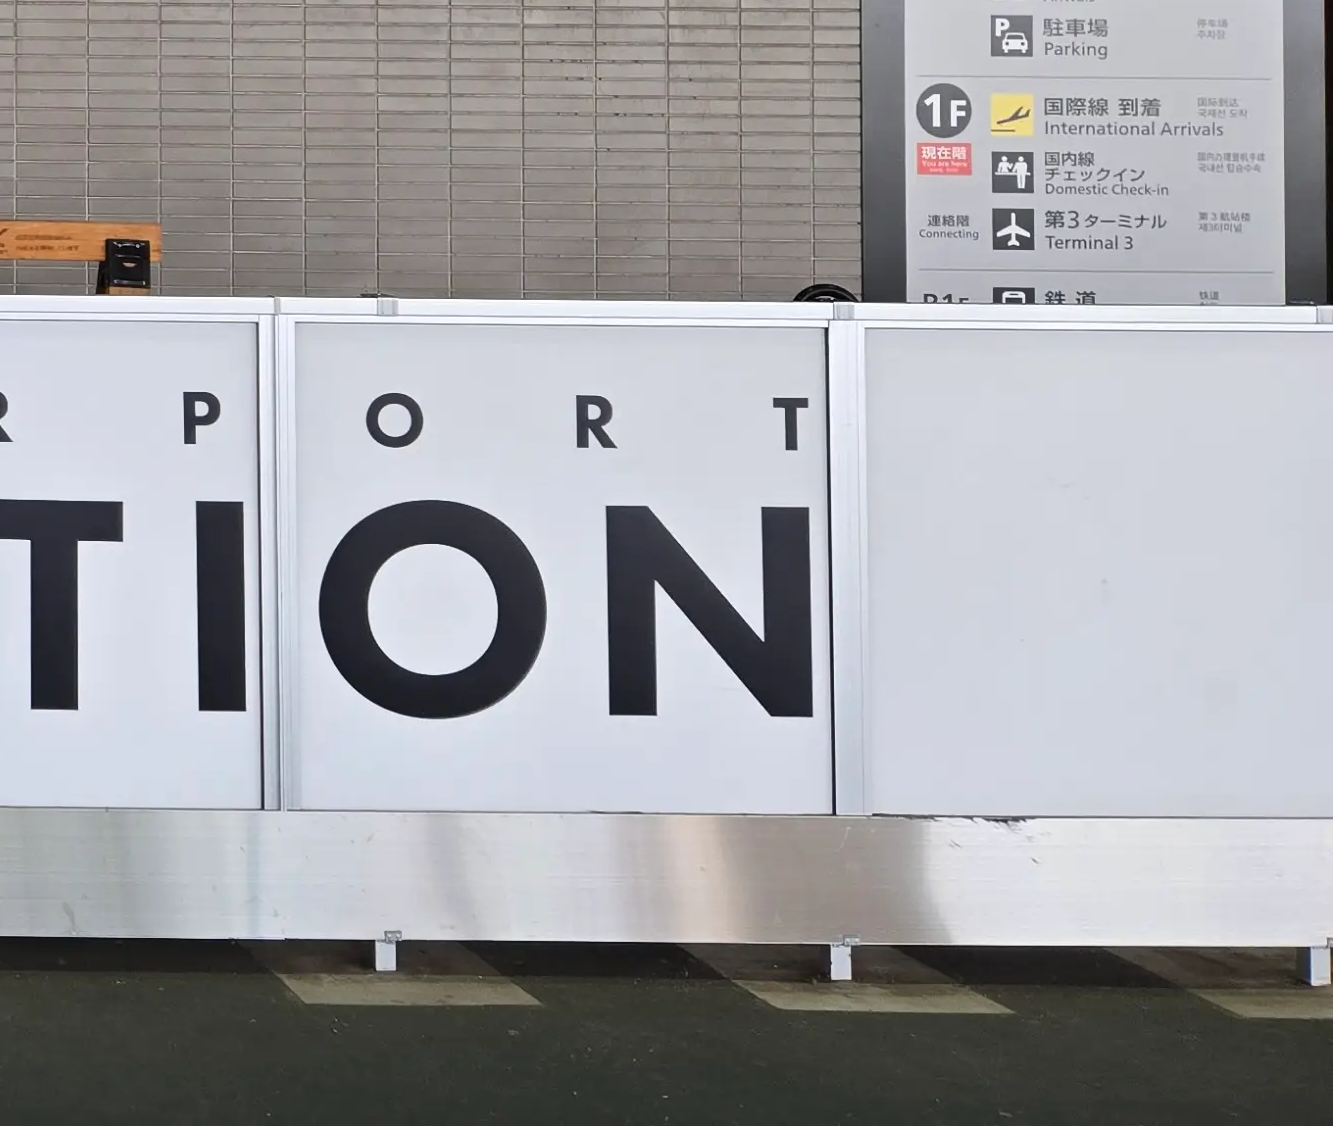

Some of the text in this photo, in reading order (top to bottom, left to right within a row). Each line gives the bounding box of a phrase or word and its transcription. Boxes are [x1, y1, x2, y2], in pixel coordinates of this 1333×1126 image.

[1043, 18, 1108, 37] 駐車場
[1045, 42, 1107, 60] Parking
[924, 94, 967, 127] 1F
[1045, 98, 1161, 116] 国際線 到着
[1046, 122, 1223, 136] International Arrivals
[921, 146, 968, 160] 現在階
[1045, 152, 1094, 167] 国内線
[1045, 168, 1145, 182] チェックイン
[1046, 183, 1168, 195] Domestic Check-in
[928, 215, 969, 227] 連絡階
[1045, 210, 1166, 229] 第3ターミナル
[919, 229, 979, 240] Connecting
[1045, 235, 1133, 250] Terminal 3
